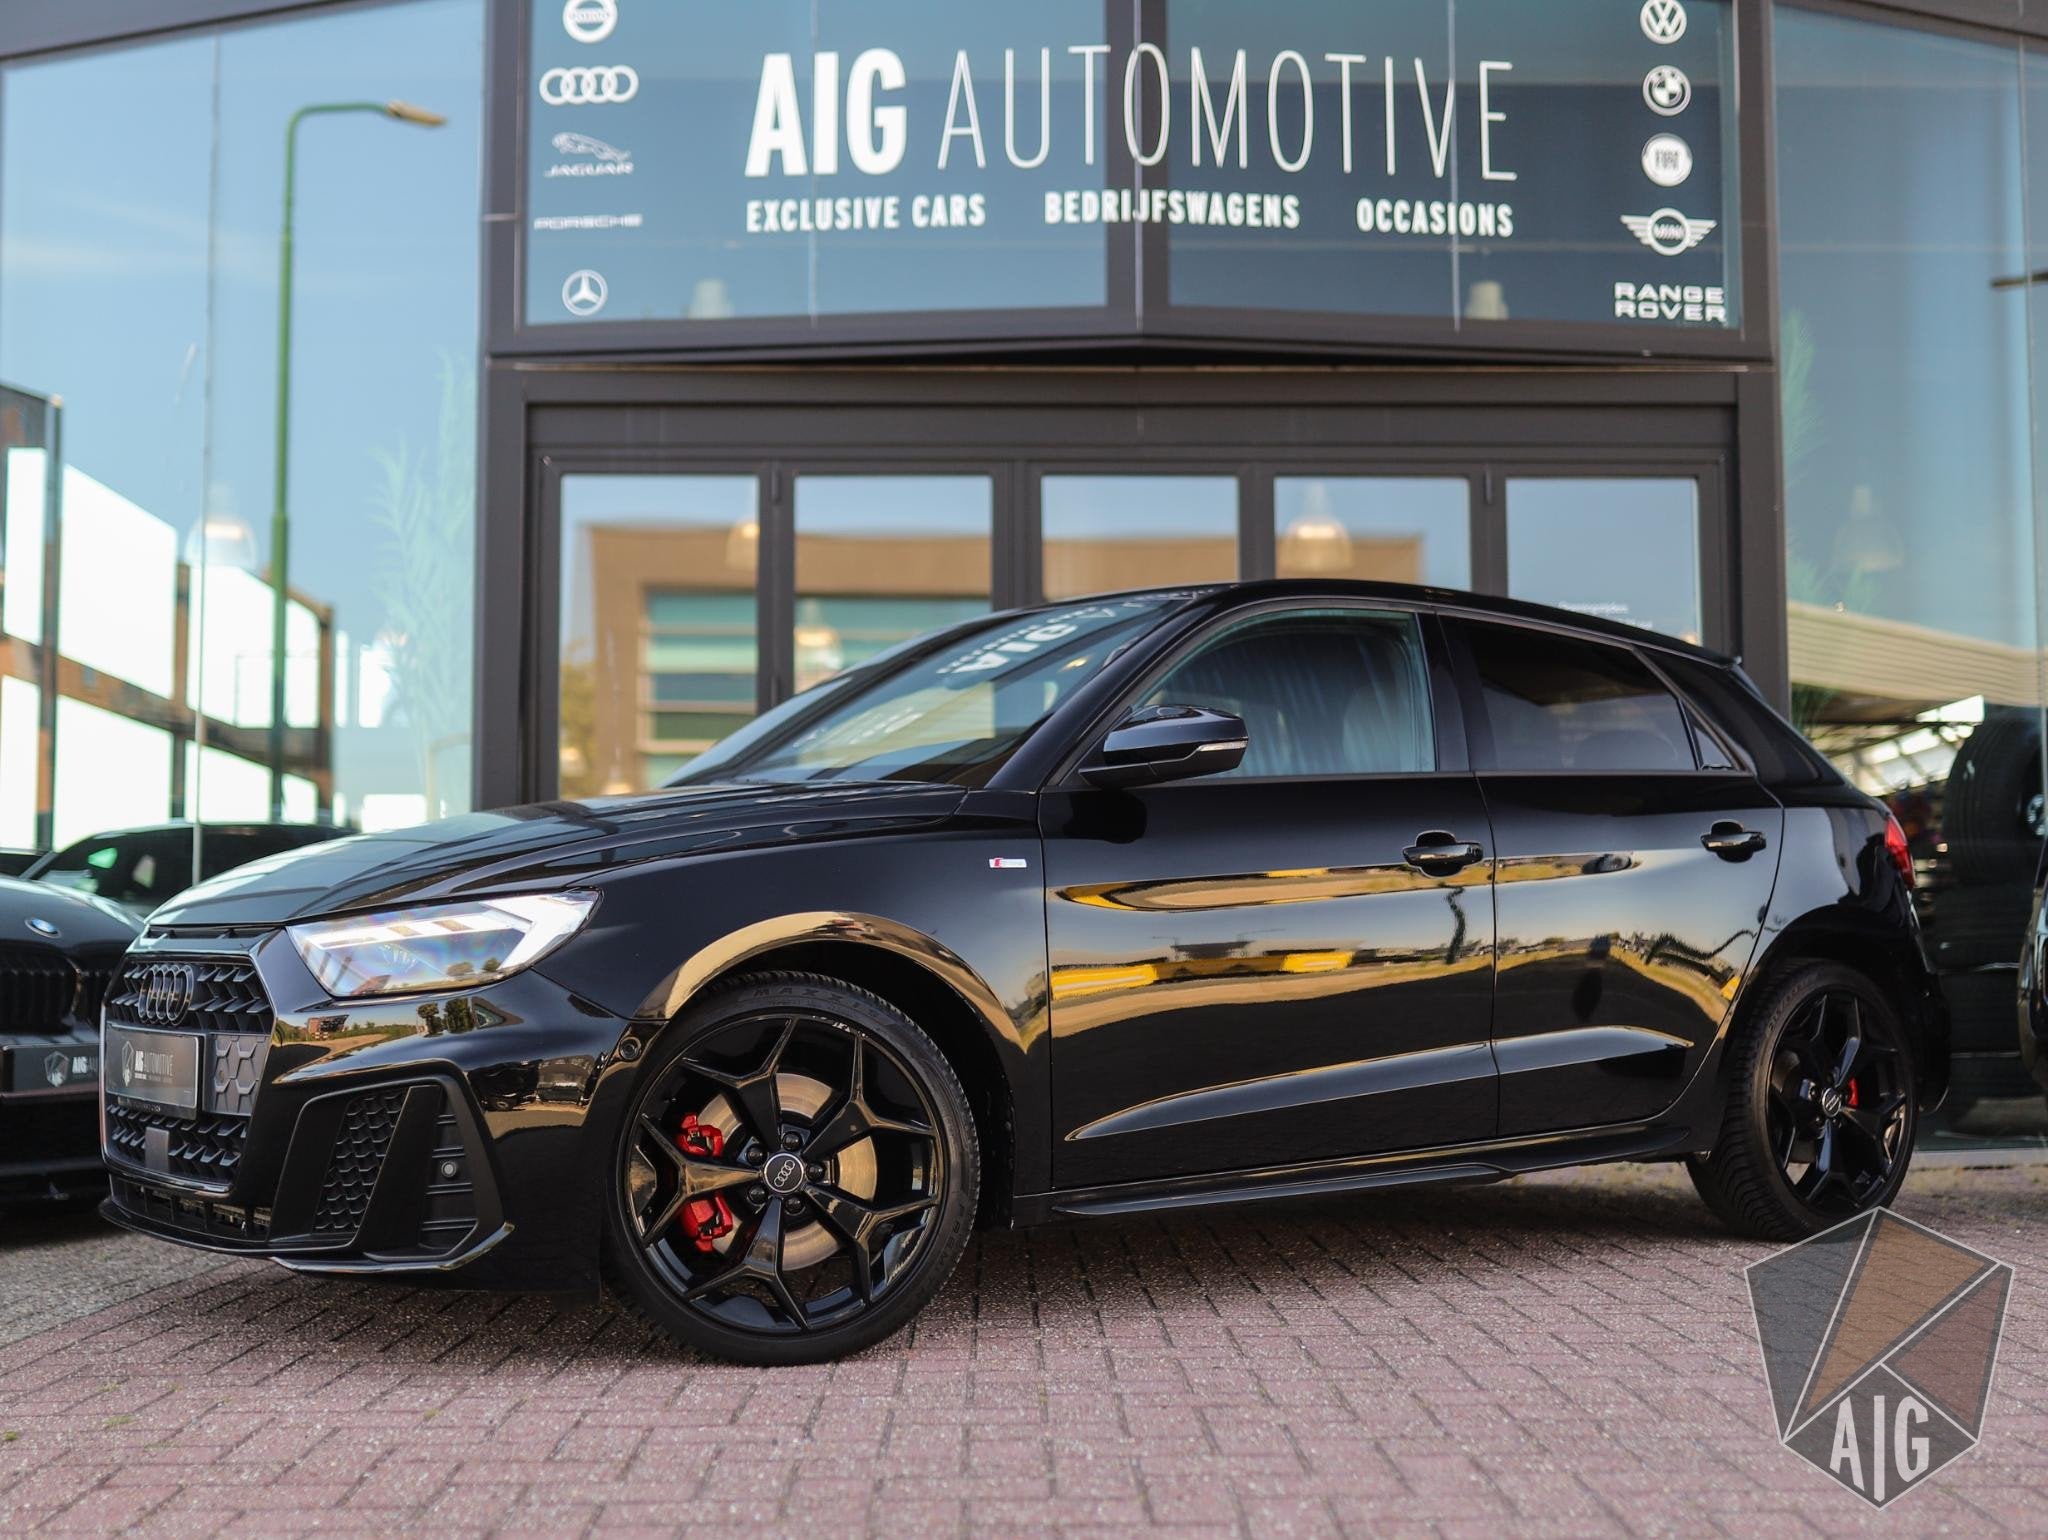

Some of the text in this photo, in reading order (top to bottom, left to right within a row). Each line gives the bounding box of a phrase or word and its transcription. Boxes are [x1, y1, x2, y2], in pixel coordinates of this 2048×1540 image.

[745, 43, 1518, 181] AIG AUTOMOTIVE
[544, 161, 635, 178] JAGUAR
[533, 213, 643, 230] PORSCHE
[746, 193, 987, 233] EXCLUSIVE CARS
[1045, 188, 1301, 230] BEDRIJFSWAGENS
[1356, 198, 1514, 238] OCCASIONS
[1614, 281, 1724, 304] RANGE
[1614, 300, 1728, 323] ROVER
